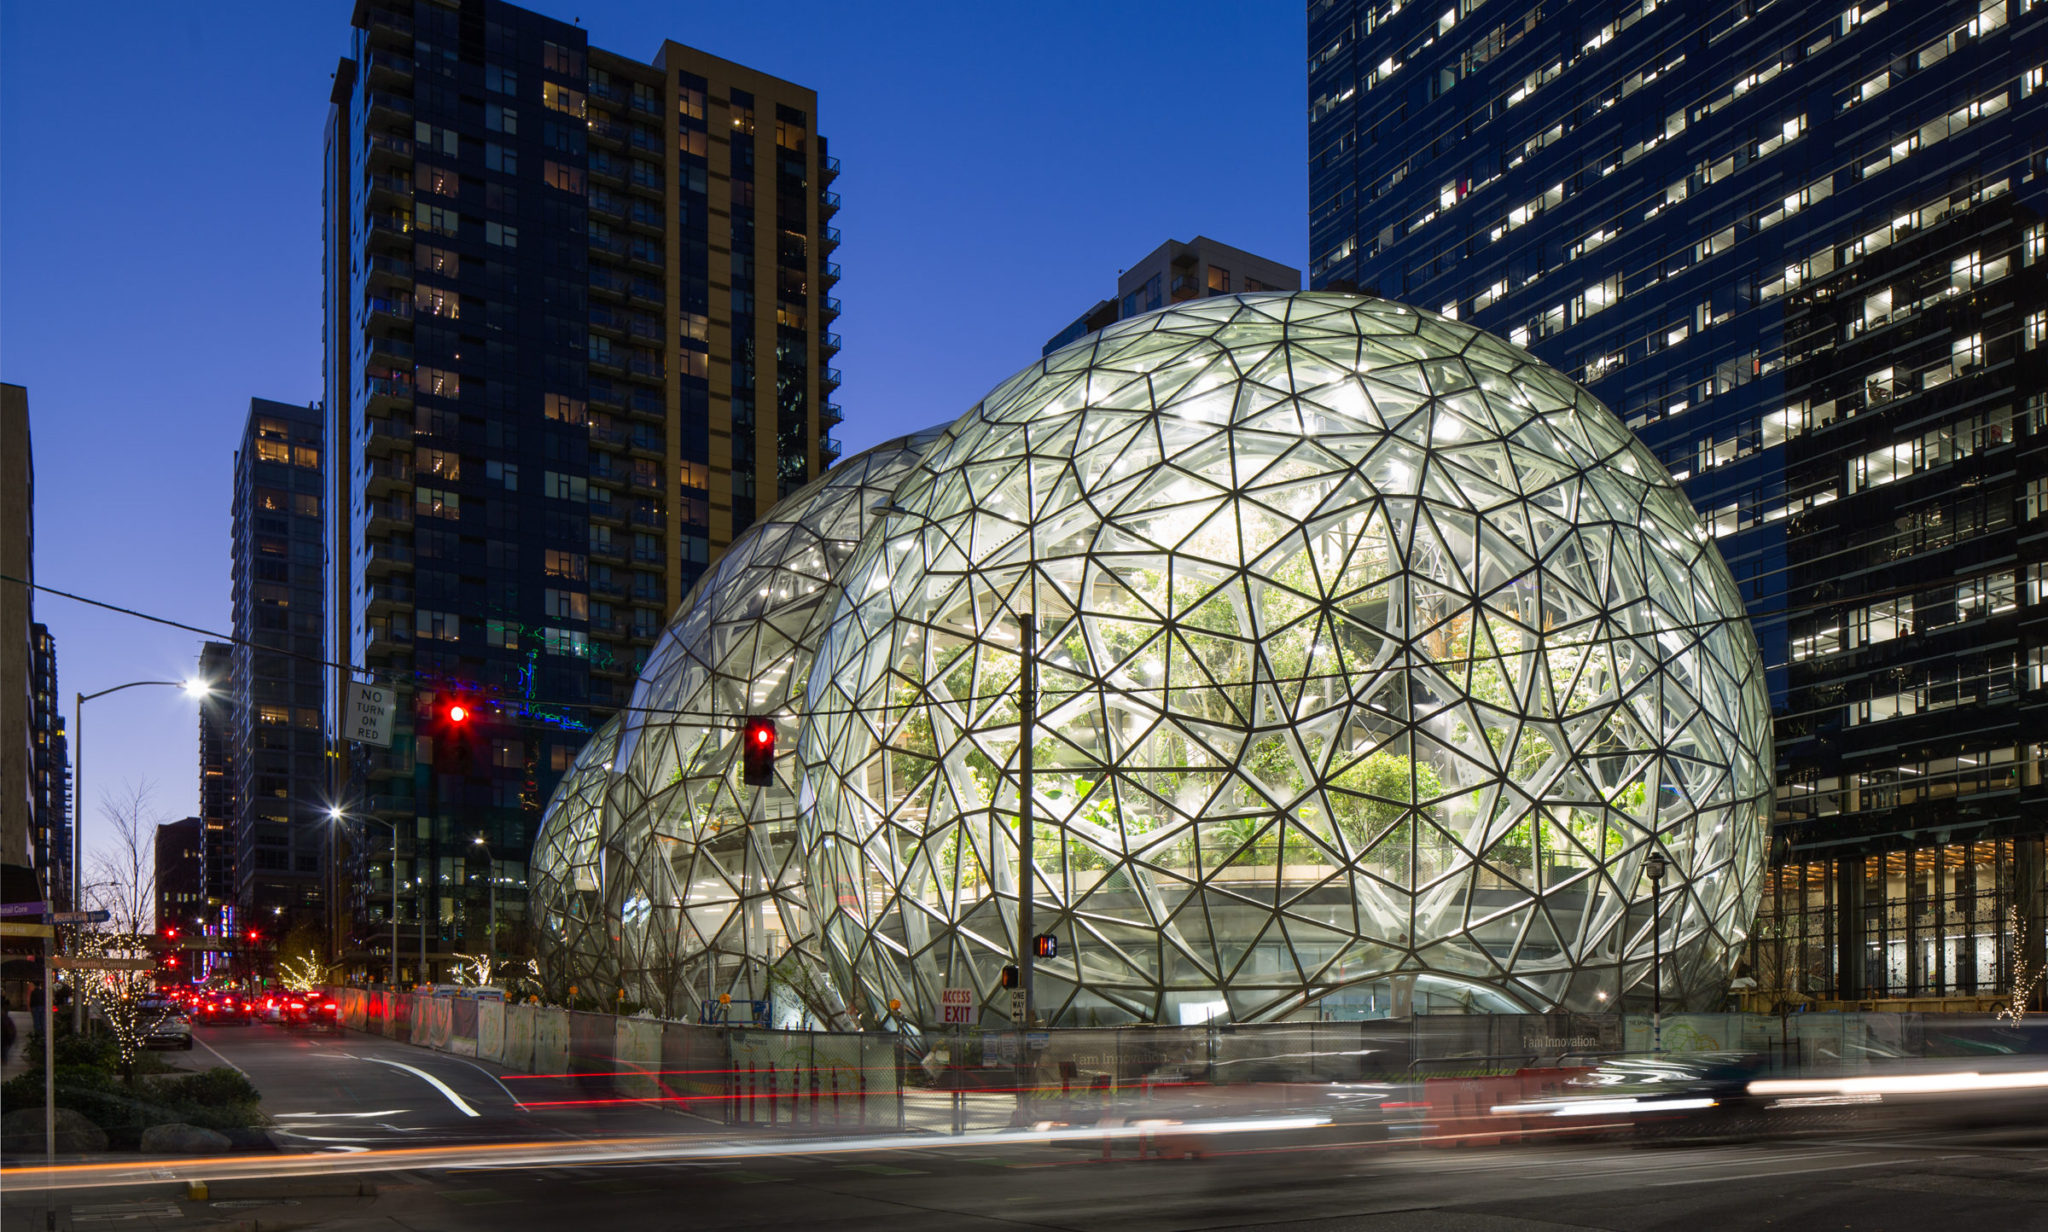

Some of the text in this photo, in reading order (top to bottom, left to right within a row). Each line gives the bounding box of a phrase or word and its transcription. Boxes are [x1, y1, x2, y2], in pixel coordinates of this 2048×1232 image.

[361, 688, 382, 702] NO
[357, 702, 385, 716] TURN
[362, 716, 377, 727] ON
[358, 727, 379, 740] RED
[942, 990, 971, 1003] ACCESS
[1012, 991, 1024, 1000] ONE
[1012, 1000, 1024, 1009] WAY
[945, 1006, 971, 1022] EXIT
[1528, 1038, 1543, 1048] am
[1079, 1055, 1100, 1065] am
